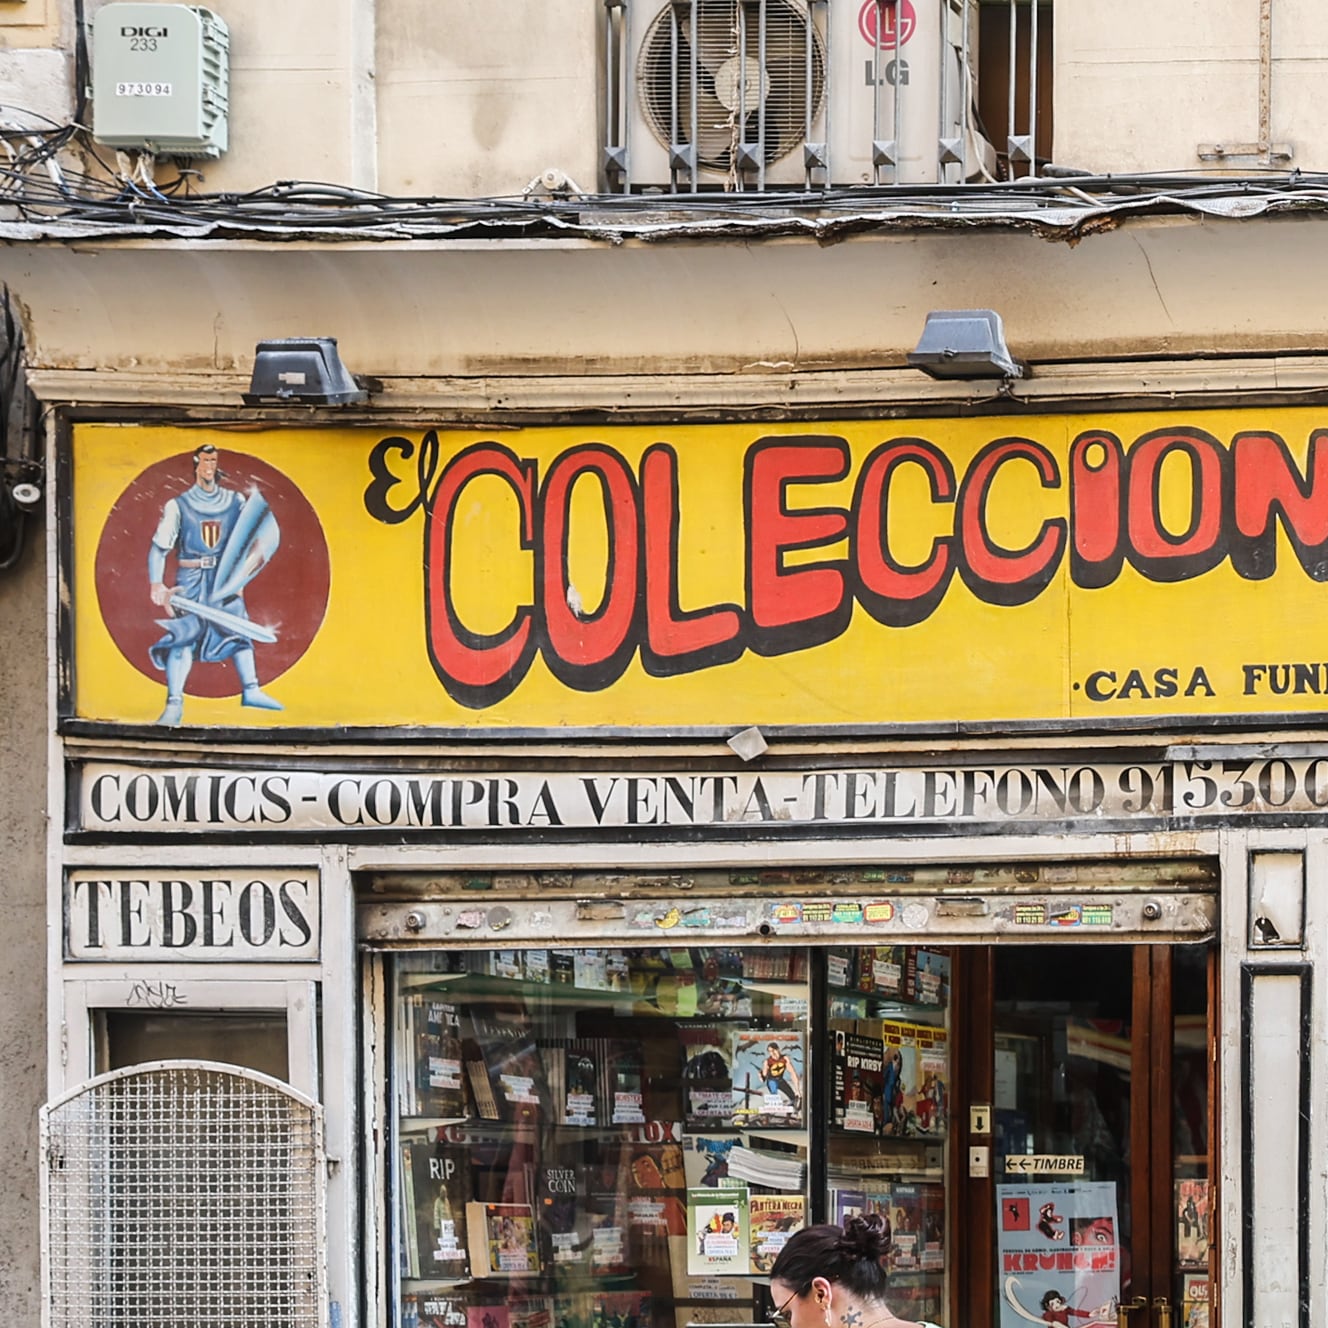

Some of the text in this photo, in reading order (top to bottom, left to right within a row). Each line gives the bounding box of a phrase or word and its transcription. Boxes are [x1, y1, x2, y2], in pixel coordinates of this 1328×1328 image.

[120, 27, 168, 37] DIGI
[130, 38, 158, 51] 233
[865, 59, 910, 86] LG
[118, 84, 170, 94] 973094
[363, 429, 438, 524] El
[1084, 667, 1216, 702] CASA
[90, 774, 293, 822] COMICS
[331, 778, 563, 826] COMPRA
[579, 775, 770, 825] VENTA
[802, 767, 1104, 822] TELEFONO
[75, 879, 311, 949] TEBEOS
[847, 1056, 882, 1072] RIP KIRBY
[429, 1157, 455, 1180] RIP
[1033, 1158, 1083, 1170] TIMBRE
[547, 1169, 575, 1180] SILVER
[750, 1200, 803, 1213] PANTERA NEGRA
